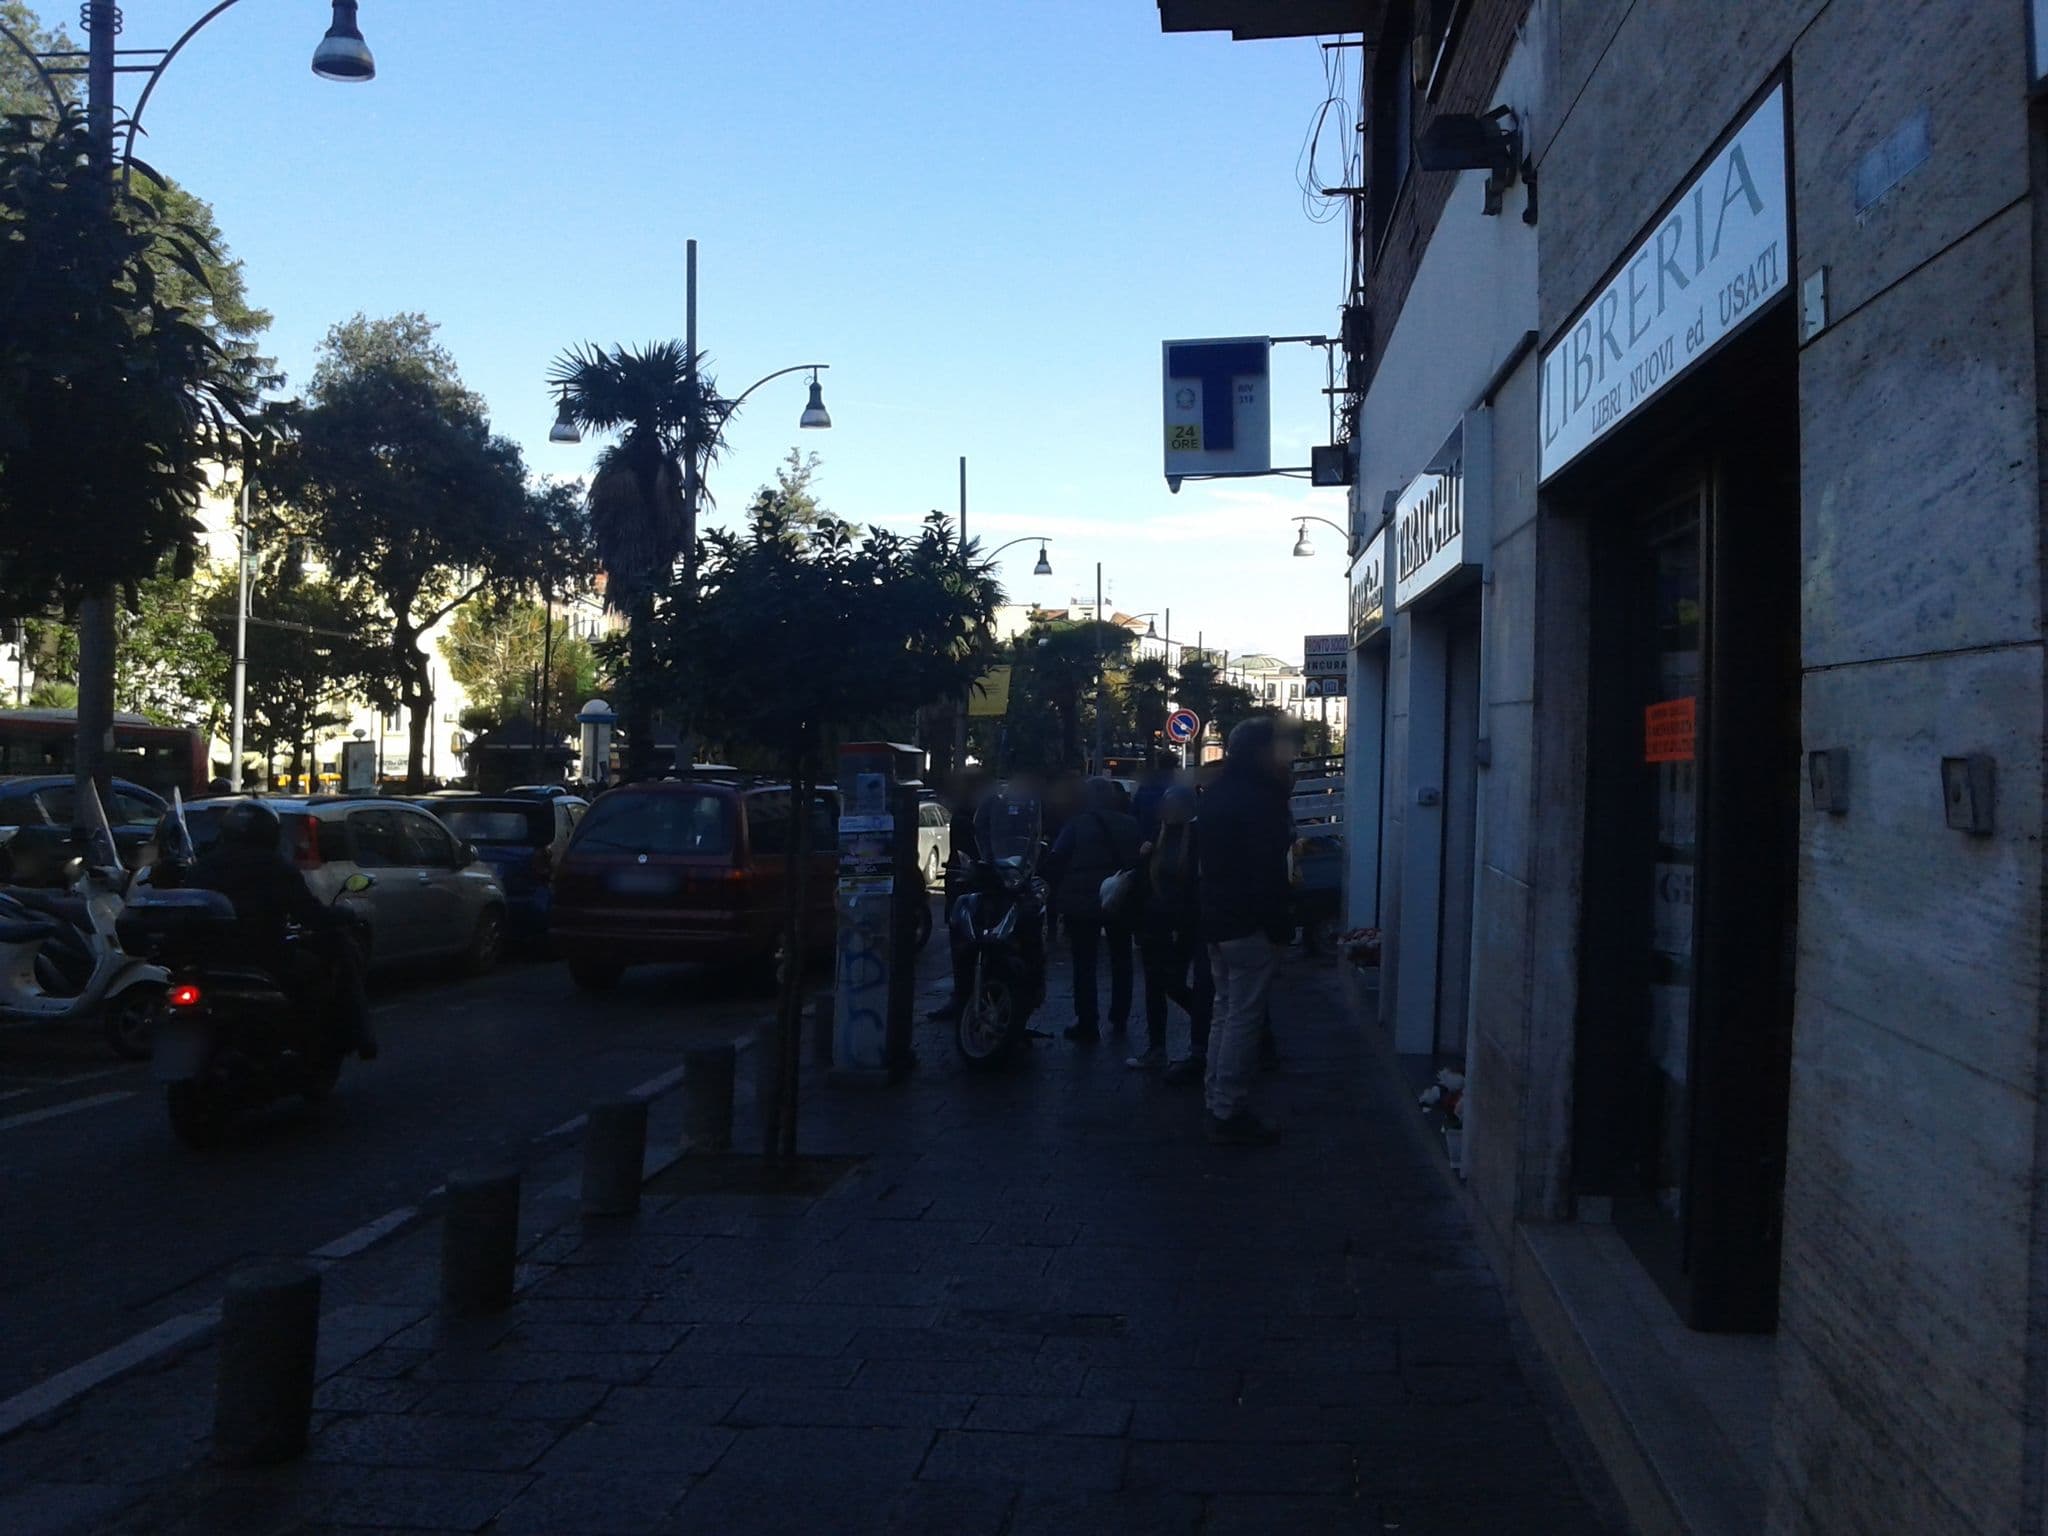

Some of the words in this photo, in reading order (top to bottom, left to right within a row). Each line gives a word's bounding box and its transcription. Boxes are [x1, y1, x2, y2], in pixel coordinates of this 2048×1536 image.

[1545, 142, 1763, 450] LIBRERIA
[1591, 382, 1622, 435] LIBRI
[1629, 334, 1675, 404] NUOVI
[1686, 306, 1706, 353] ed
[1719, 240, 1779, 327] USATI
[1169, 343, 1264, 450] T
[1171, 439, 1198, 450] ORE
[1175, 426, 1195, 438] 24
